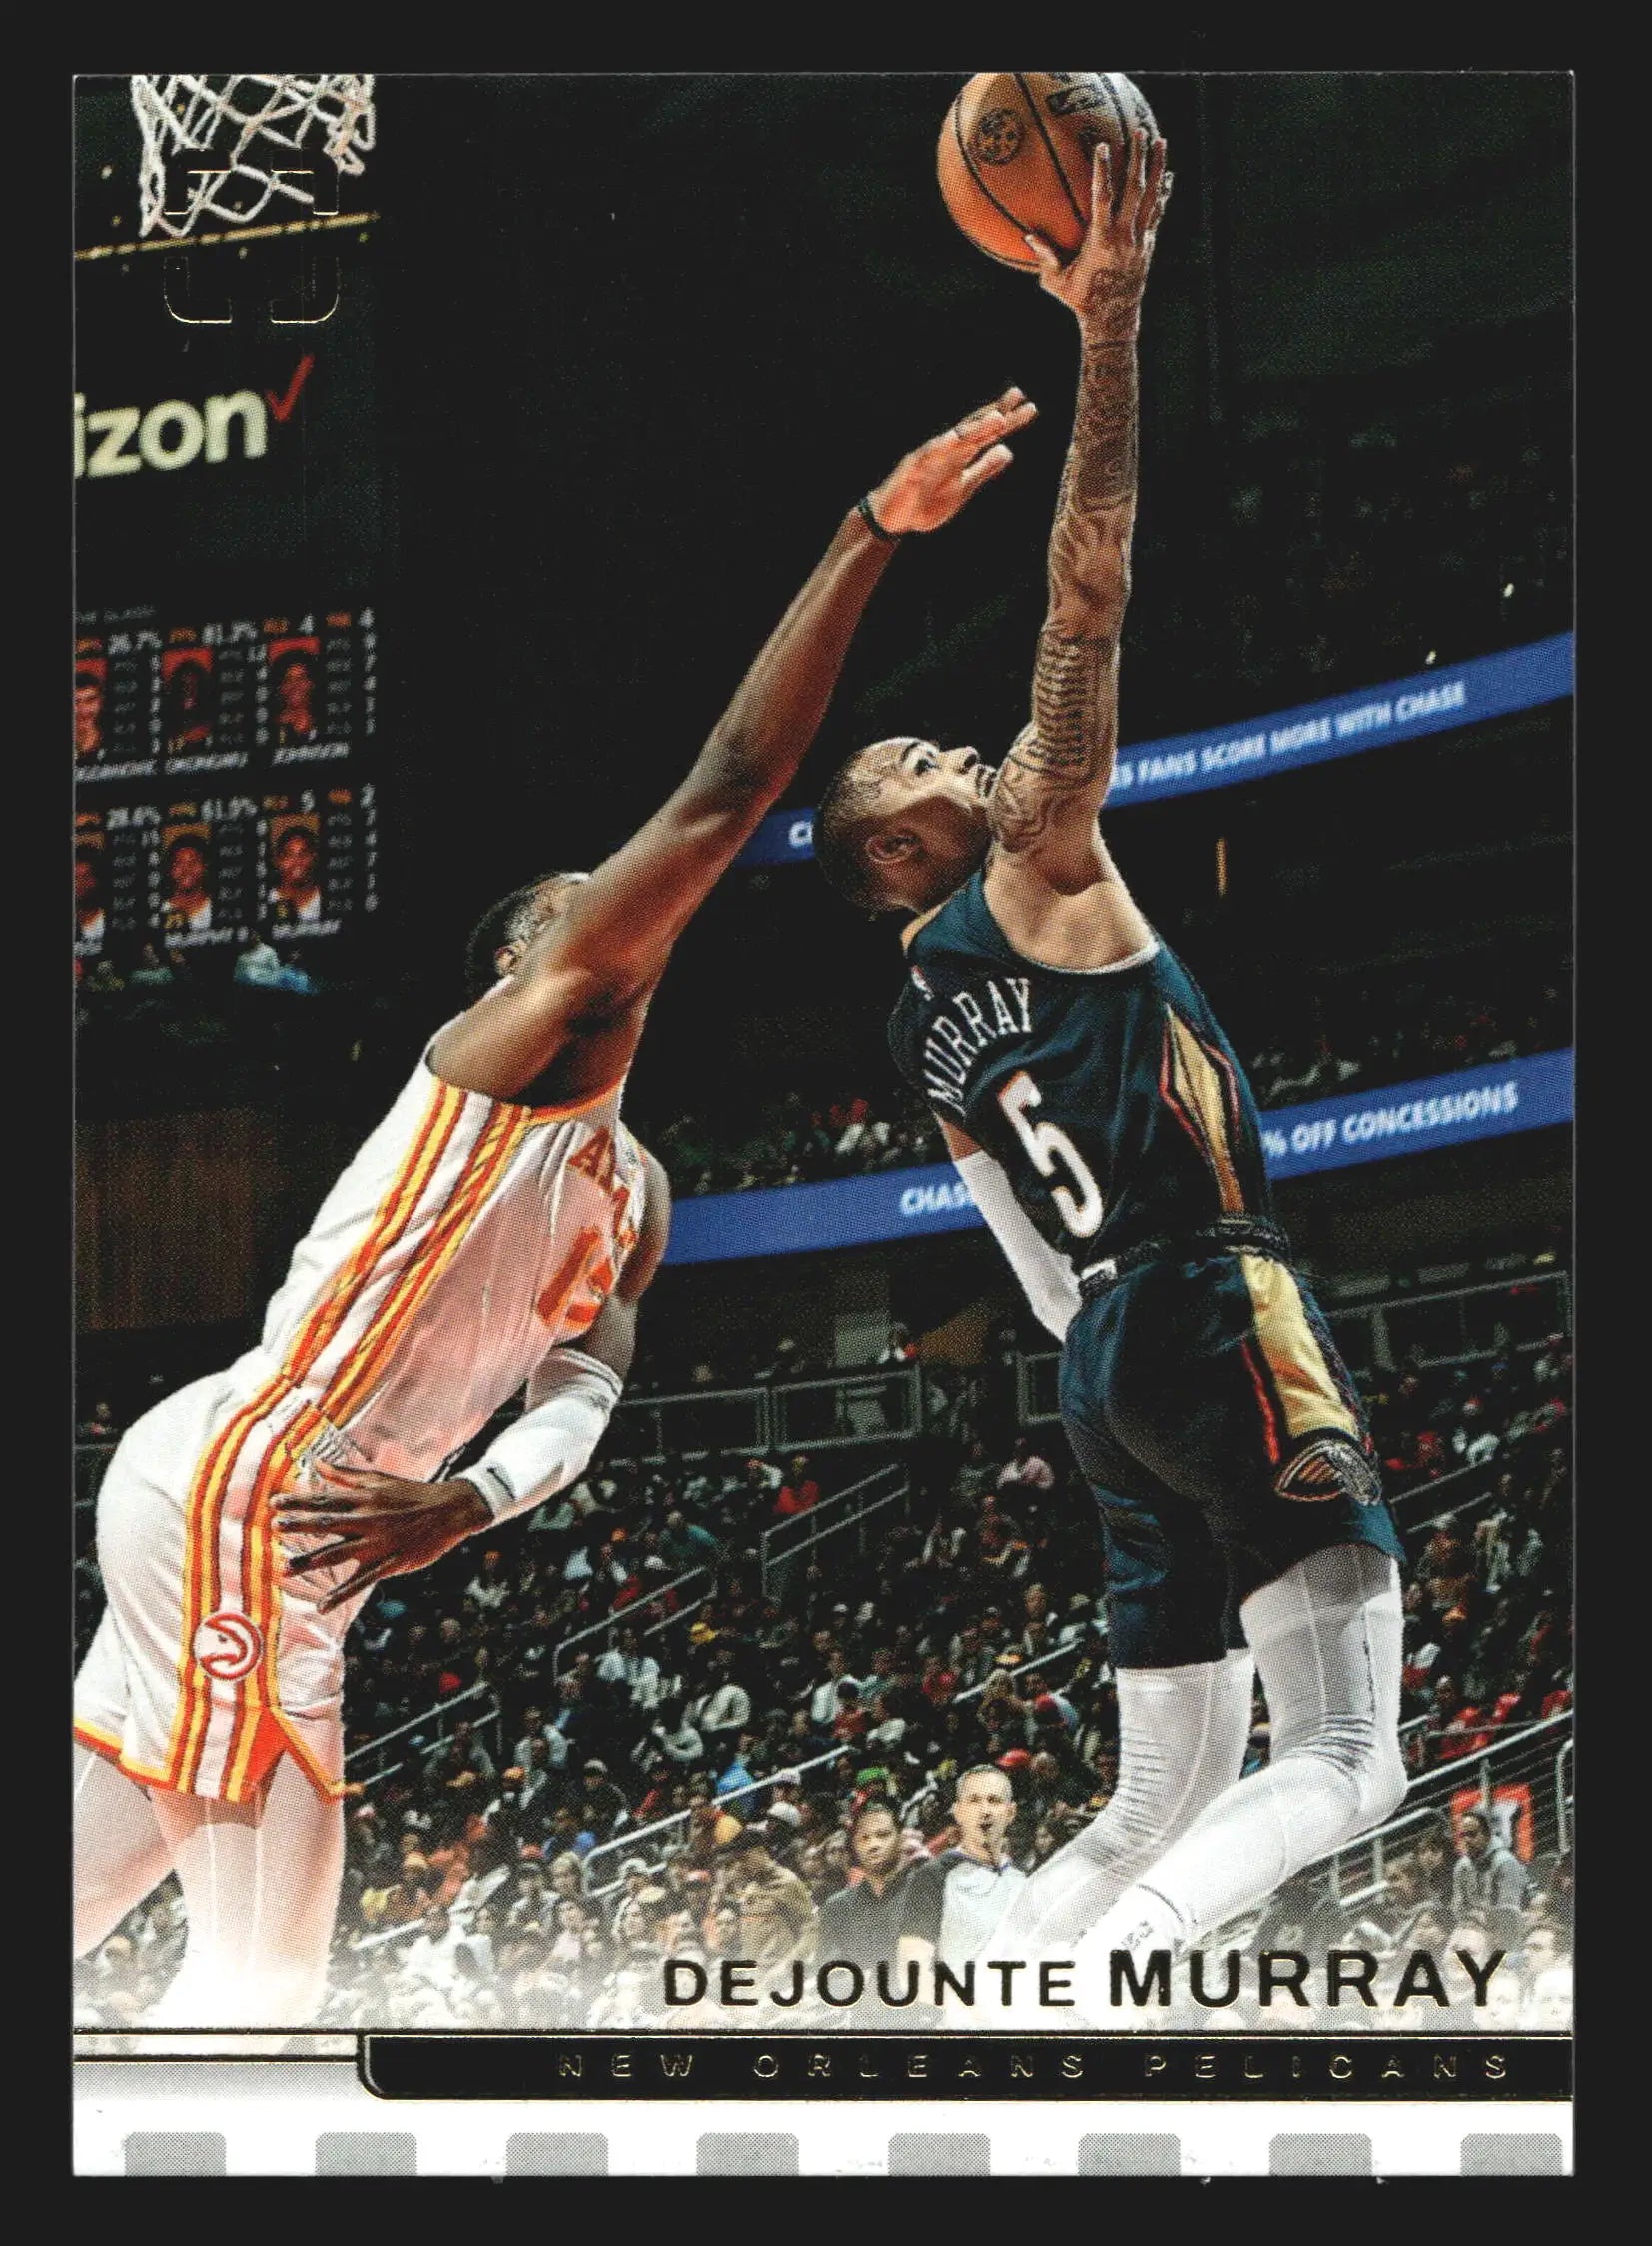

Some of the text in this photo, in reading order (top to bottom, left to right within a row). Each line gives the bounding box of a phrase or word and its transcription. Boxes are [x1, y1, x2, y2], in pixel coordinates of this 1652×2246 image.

[1137, 750, 1197, 785] FANS
[1200, 732, 1266, 771] SCORE
[1269, 715, 1332, 753] MORE
[1335, 700, 1392, 738] WITH
[1395, 680, 1465, 723] CHASE
[923, 978, 1033, 1118] MURRAY
[901, 1181, 975, 1218] CHAS
[1291, 1118, 1337, 1155] OFF
[1341, 1079, 1519, 1145] CONCESSIONS
[997, 1069, 1104, 1238] 5
[663, 1949, 1508, 2009] DEJOUNTE MURRAY
[559, 2053, 1508, 2079] NEW ORLEANS PELICANS
